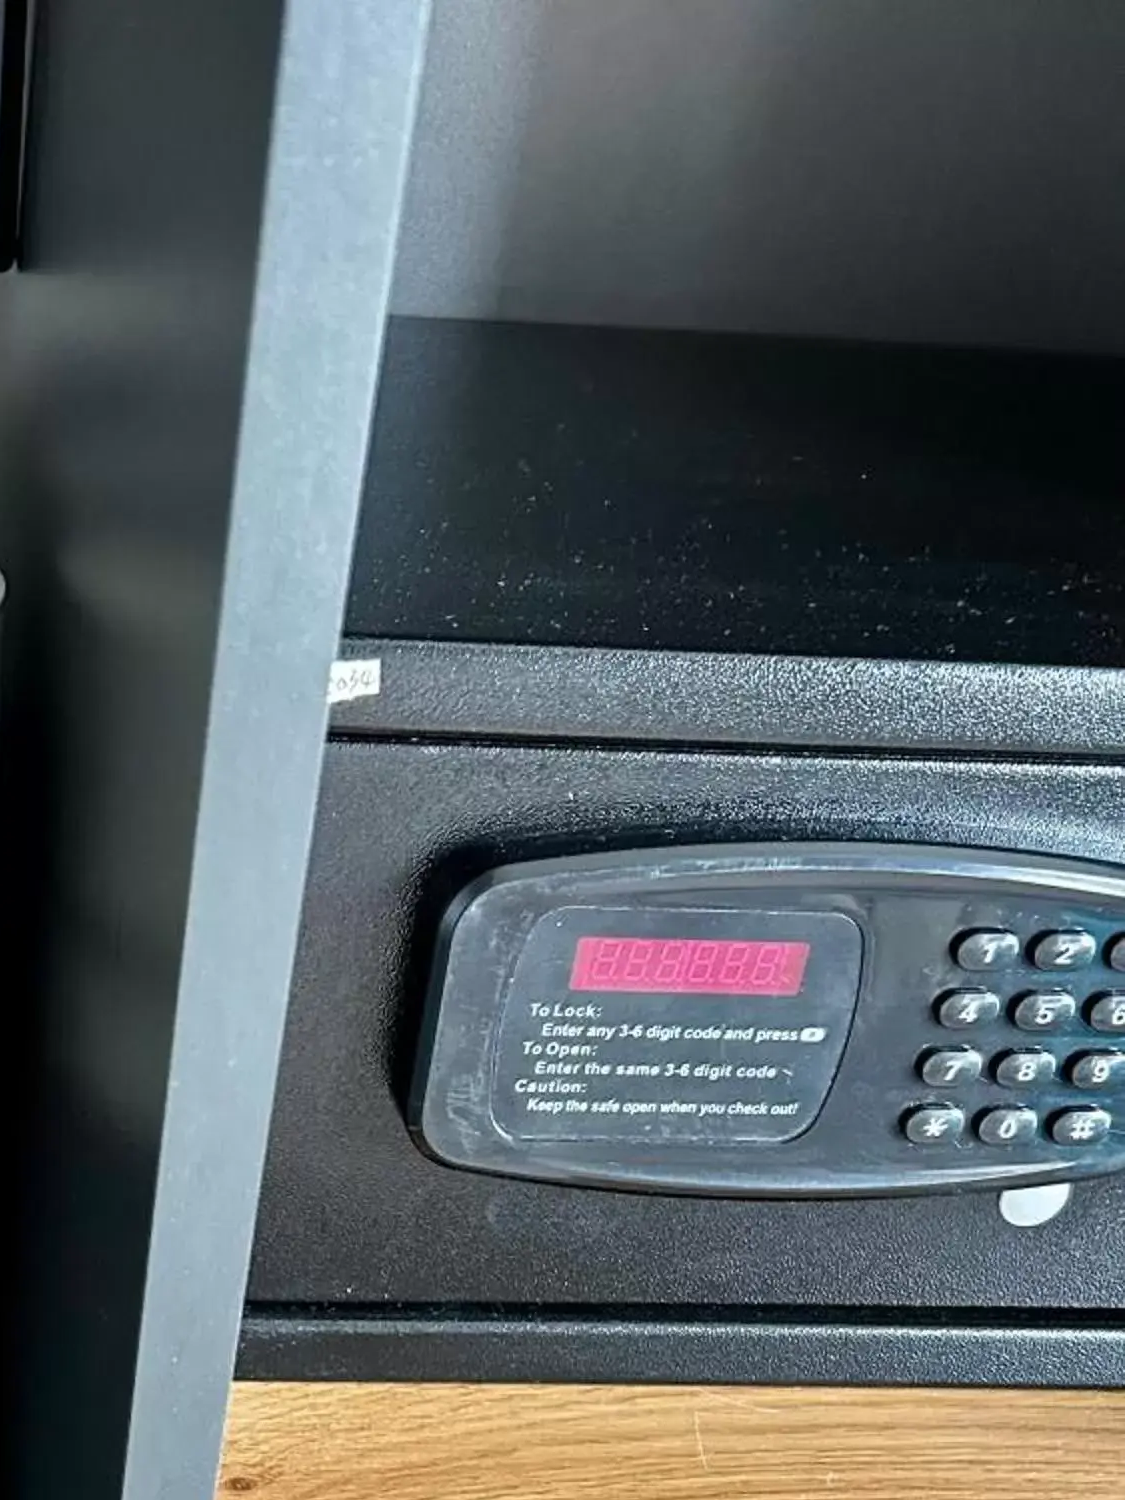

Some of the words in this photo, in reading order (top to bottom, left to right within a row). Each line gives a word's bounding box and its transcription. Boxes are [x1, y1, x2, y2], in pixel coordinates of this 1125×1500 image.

[529, 1003, 550, 1017] To
[553, 1003, 603, 1018] Lock:
[958, 1004, 978, 1023] 4
[1034, 1006, 1055, 1024] 5
[542, 1023, 584, 1038] Enter
[586, 1025, 615, 1040] any
[619, 1024, 643, 1038] 3-6
[646, 1024, 680, 1041] digit
[684, 1026, 722, 1040] code
[724, 1027, 753, 1041] and
[755, 1030, 798, 1044] press
[522, 1041, 542, 1055] To
[546, 1042, 598, 1056] Open:
[534, 1062, 580, 1076] Enter
[584, 1063, 611, 1076] the
[615, 1065, 659, 1077] same
[664, 1063, 689, 1077] 3-6
[693, 1063, 731, 1079] digit
[736, 1065, 776, 1079] code
[944, 1062, 961, 1081] 7
[1018, 1062, 1037, 1081] 8
[514, 1078, 588, 1094] Caution:
[527, 1100, 563, 1114] Keep
[565, 1100, 588, 1113] the
[591, 1101, 619, 1114] safe
[622, 1103, 656, 1115] open
[660, 1102, 697, 1114] when
[699, 1104, 724, 1117] you
[727, 1102, 768, 1115] check
[770, 1102, 798, 1116] out!
[999, 1118, 1018, 1139] 0
